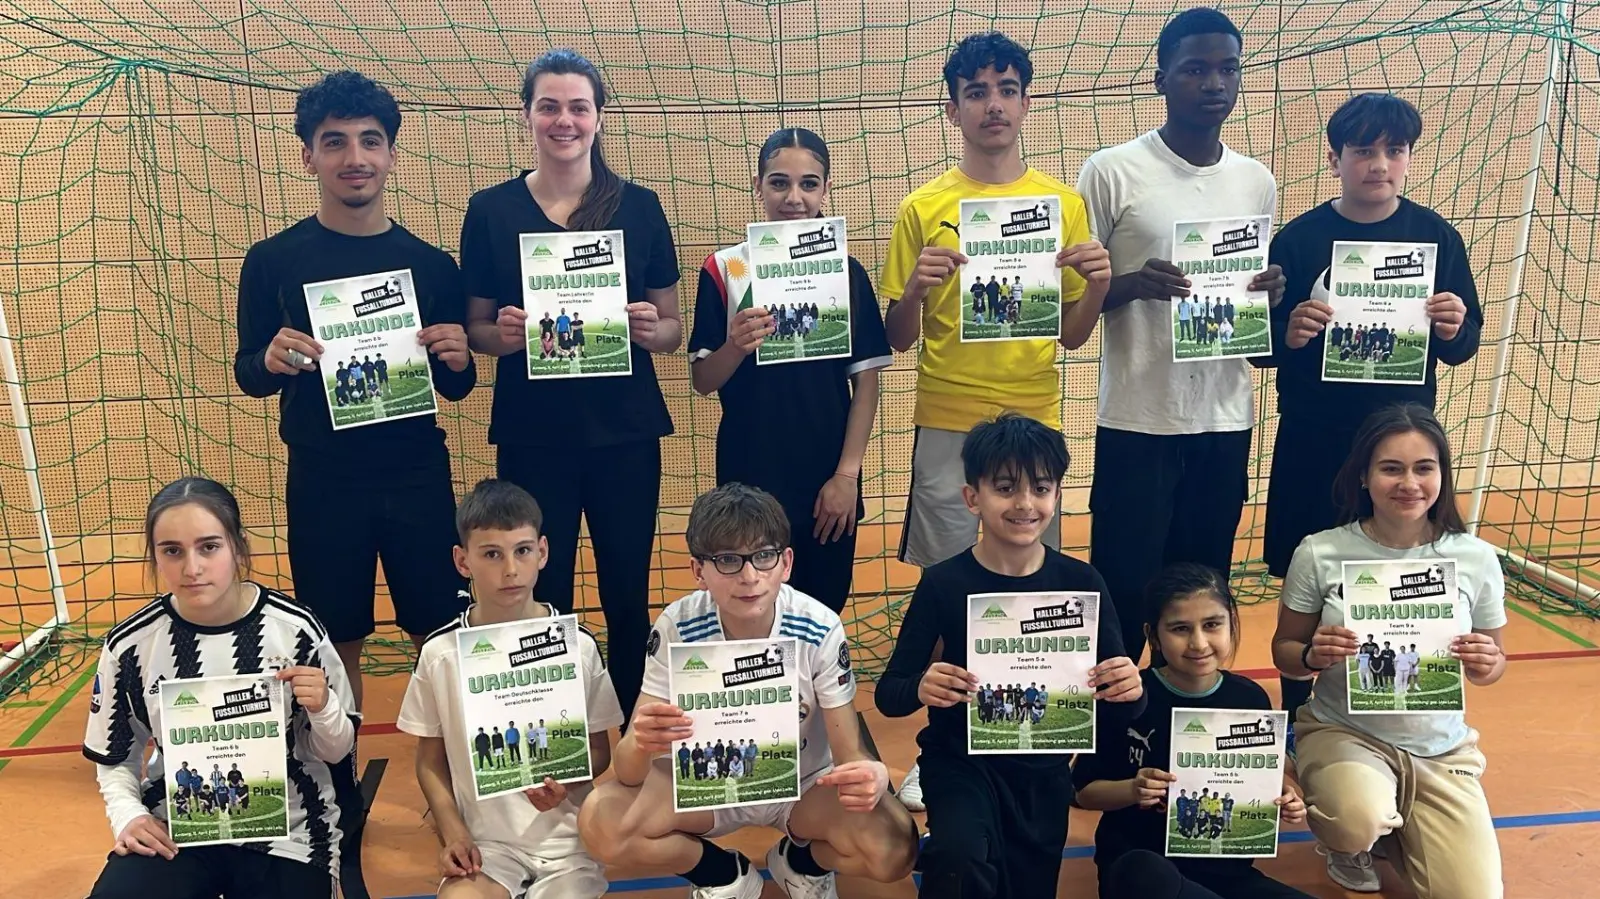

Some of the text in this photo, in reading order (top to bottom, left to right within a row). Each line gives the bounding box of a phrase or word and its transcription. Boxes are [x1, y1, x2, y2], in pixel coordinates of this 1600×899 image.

[966, 238, 1056, 256] URKUNDE
[756, 259, 843, 279] URKUNDE
[1178, 256, 1263, 275] URKUNDE
[529, 272, 621, 290] URKUNDE
[1039, 280, 1044, 290] 4
[1336, 282, 1428, 298] URKUNDE
[829, 296, 838, 312] 3
[1031, 294, 1056, 303] Platz
[1246, 298, 1253, 308] 5
[822, 313, 845, 322] Platz
[1240, 311, 1264, 319] Platz
[319, 312, 415, 340] URKUNDE
[603, 318, 610, 331] 2
[1408, 325, 1414, 335] 6
[596, 335, 621, 344] Platz
[406, 357, 411, 367] 1
[399, 370, 424, 379] Platz
[1351, 603, 1453, 620] URKUNDE
[975, 636, 1090, 654] URKUNDE
[1432, 649, 1448, 659] 12
[1427, 663, 1456, 672] Platz
[469, 663, 576, 693] URKUNDE
[1063, 685, 1078, 696] 10
[678, 685, 792, 711] URKUNDE
[1057, 699, 1088, 709] Platz
[560, 709, 569, 726] 8
[169, 721, 279, 745] URKUNDE
[552, 728, 581, 739] Platz
[772, 731, 779, 747] 9
[762, 750, 792, 760] Platz
[1177, 752, 1278, 769] URKUNDE
[263, 771, 269, 782] 7
[253, 786, 282, 796] Platz
[1249, 798, 1260, 809] 11
[1240, 811, 1267, 820] Platz
